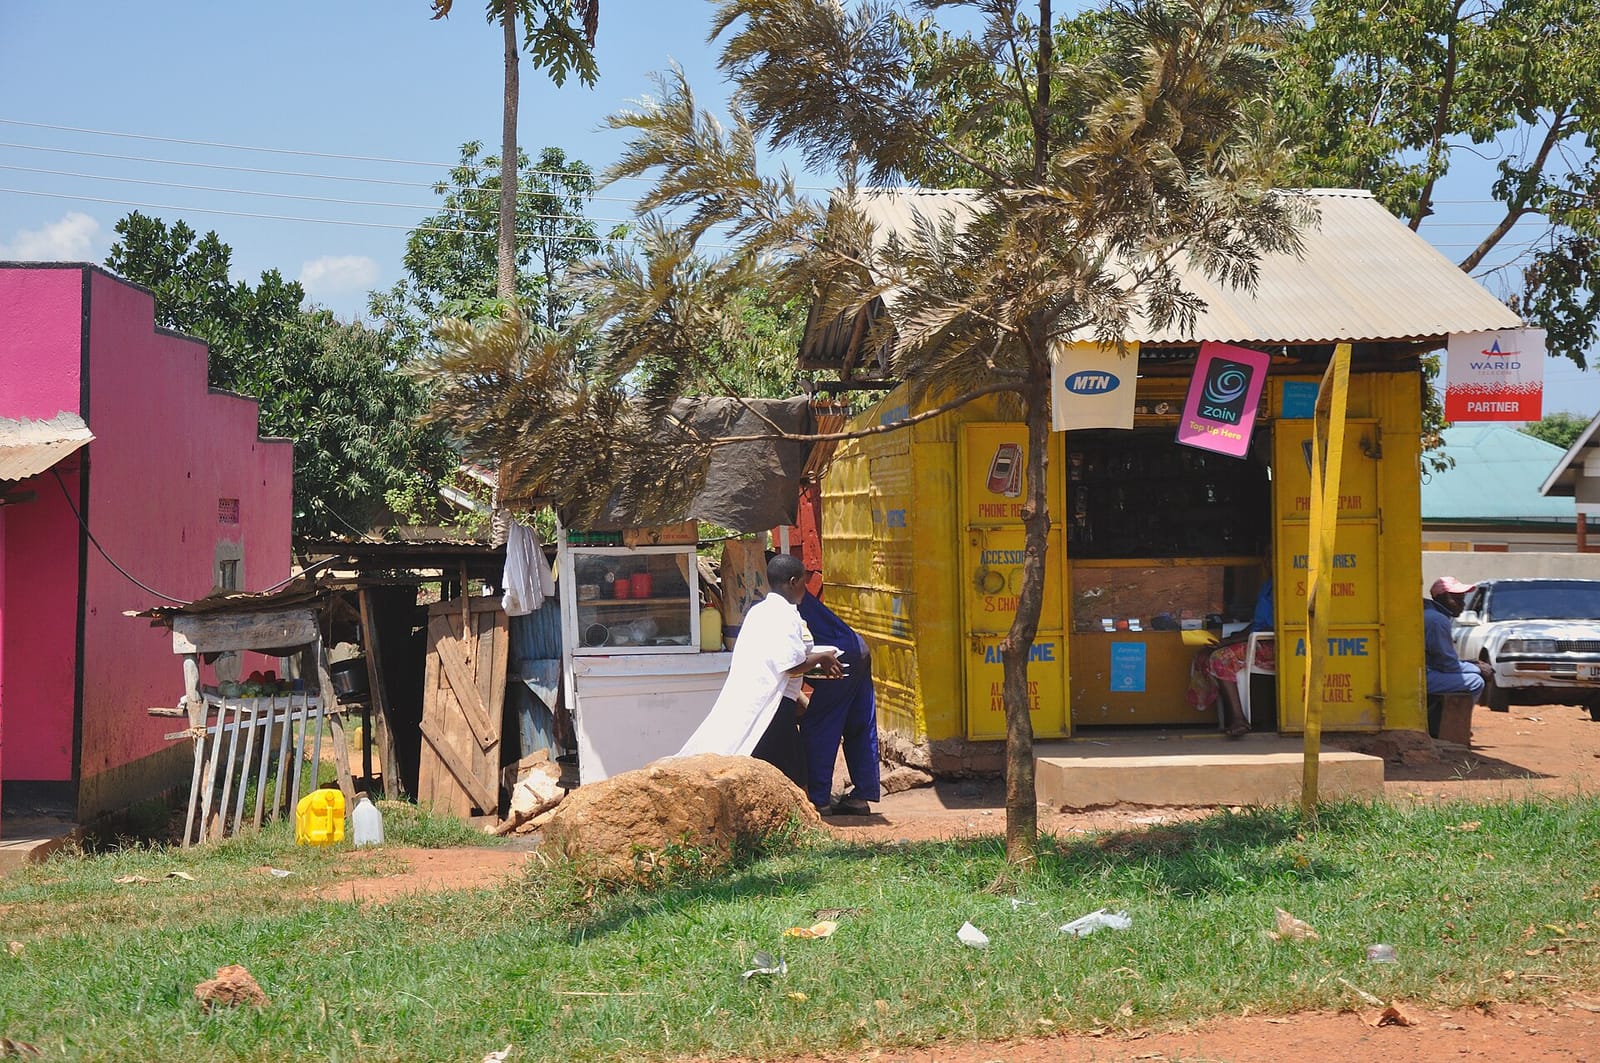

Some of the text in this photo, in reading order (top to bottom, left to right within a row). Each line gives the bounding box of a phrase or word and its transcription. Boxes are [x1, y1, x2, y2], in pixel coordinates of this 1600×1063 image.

[1470, 362, 1521, 370] WARID
[1073, 376, 1110, 390] MTN
[1467, 401, 1519, 413] PARTNER
[1190, 420, 1242, 440] Top Up Here
[979, 503, 1008, 518] PHONE
